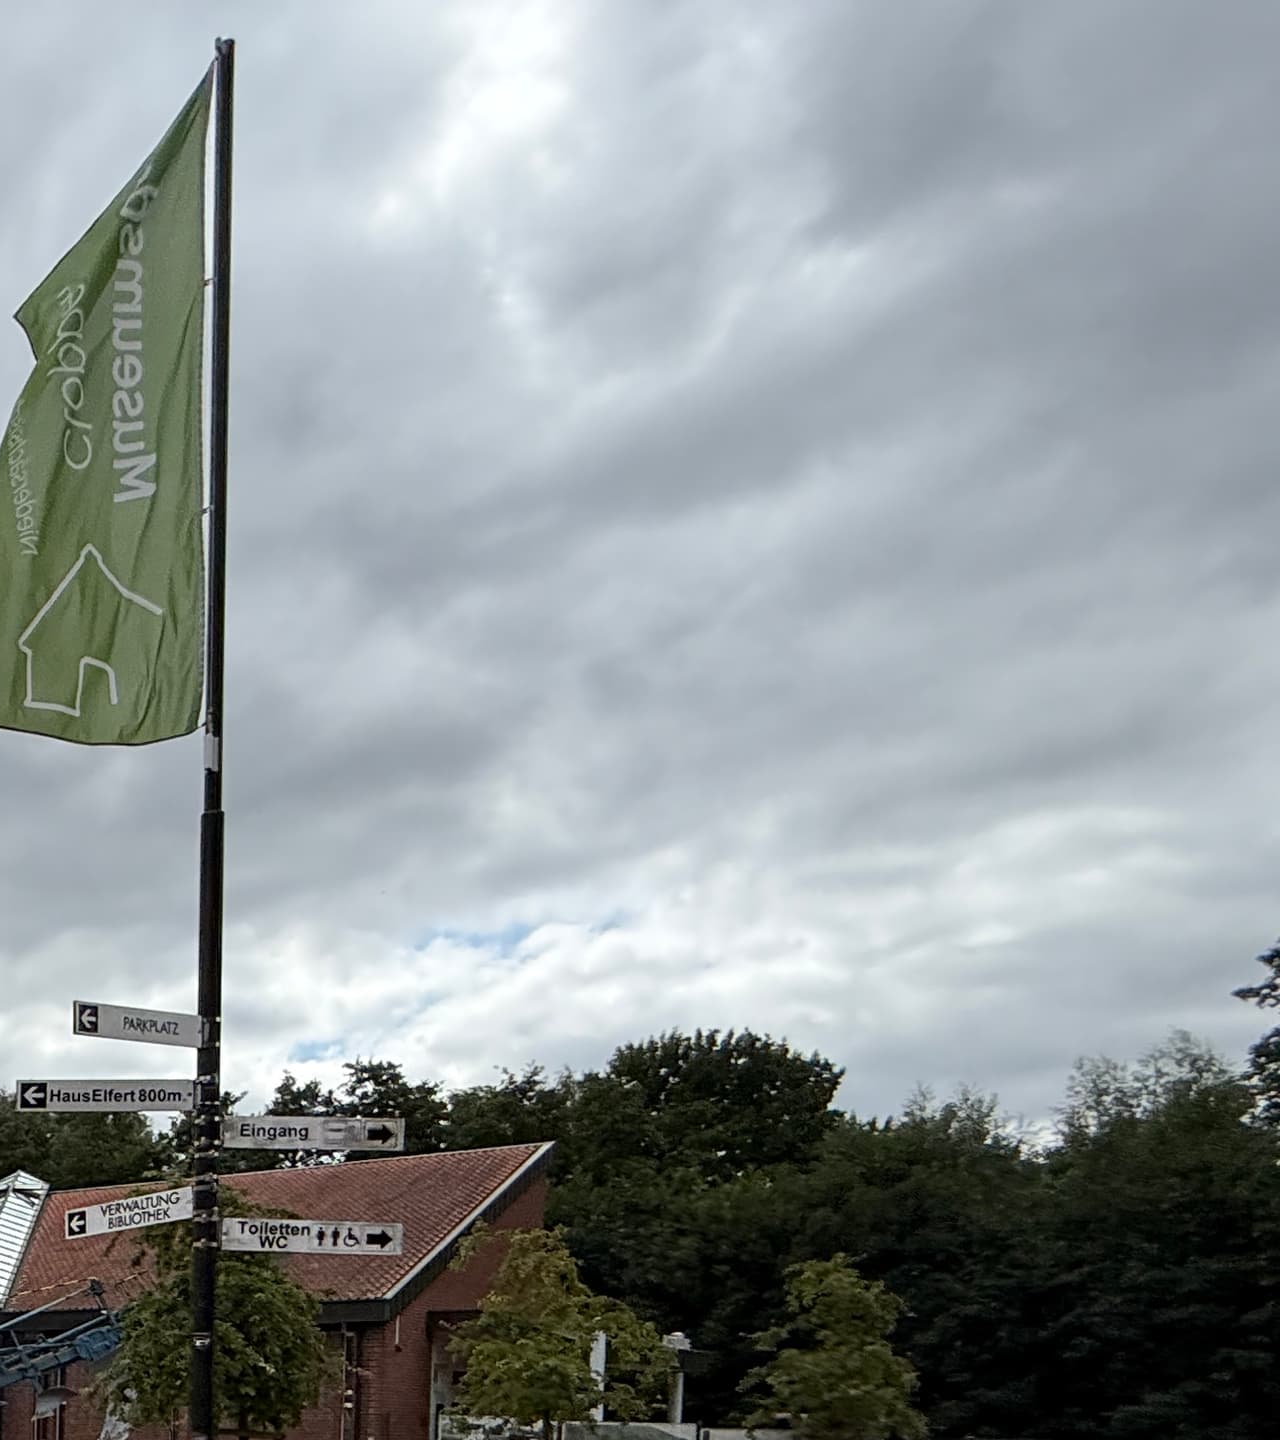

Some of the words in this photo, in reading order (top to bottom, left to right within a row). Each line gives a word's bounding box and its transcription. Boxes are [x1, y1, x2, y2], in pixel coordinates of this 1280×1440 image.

[122, 1016, 180, 1036] PARKPLATZ
[138, 1088, 182, 1103] 800m
[240, 1123, 309, 1141] Eingang
[100, 1191, 180, 1217] VERWALTUNG
[108, 1206, 171, 1230] BIBLIOTHEK
[238, 1221, 311, 1236] Toiletten
[259, 1236, 288, 1249] WC
